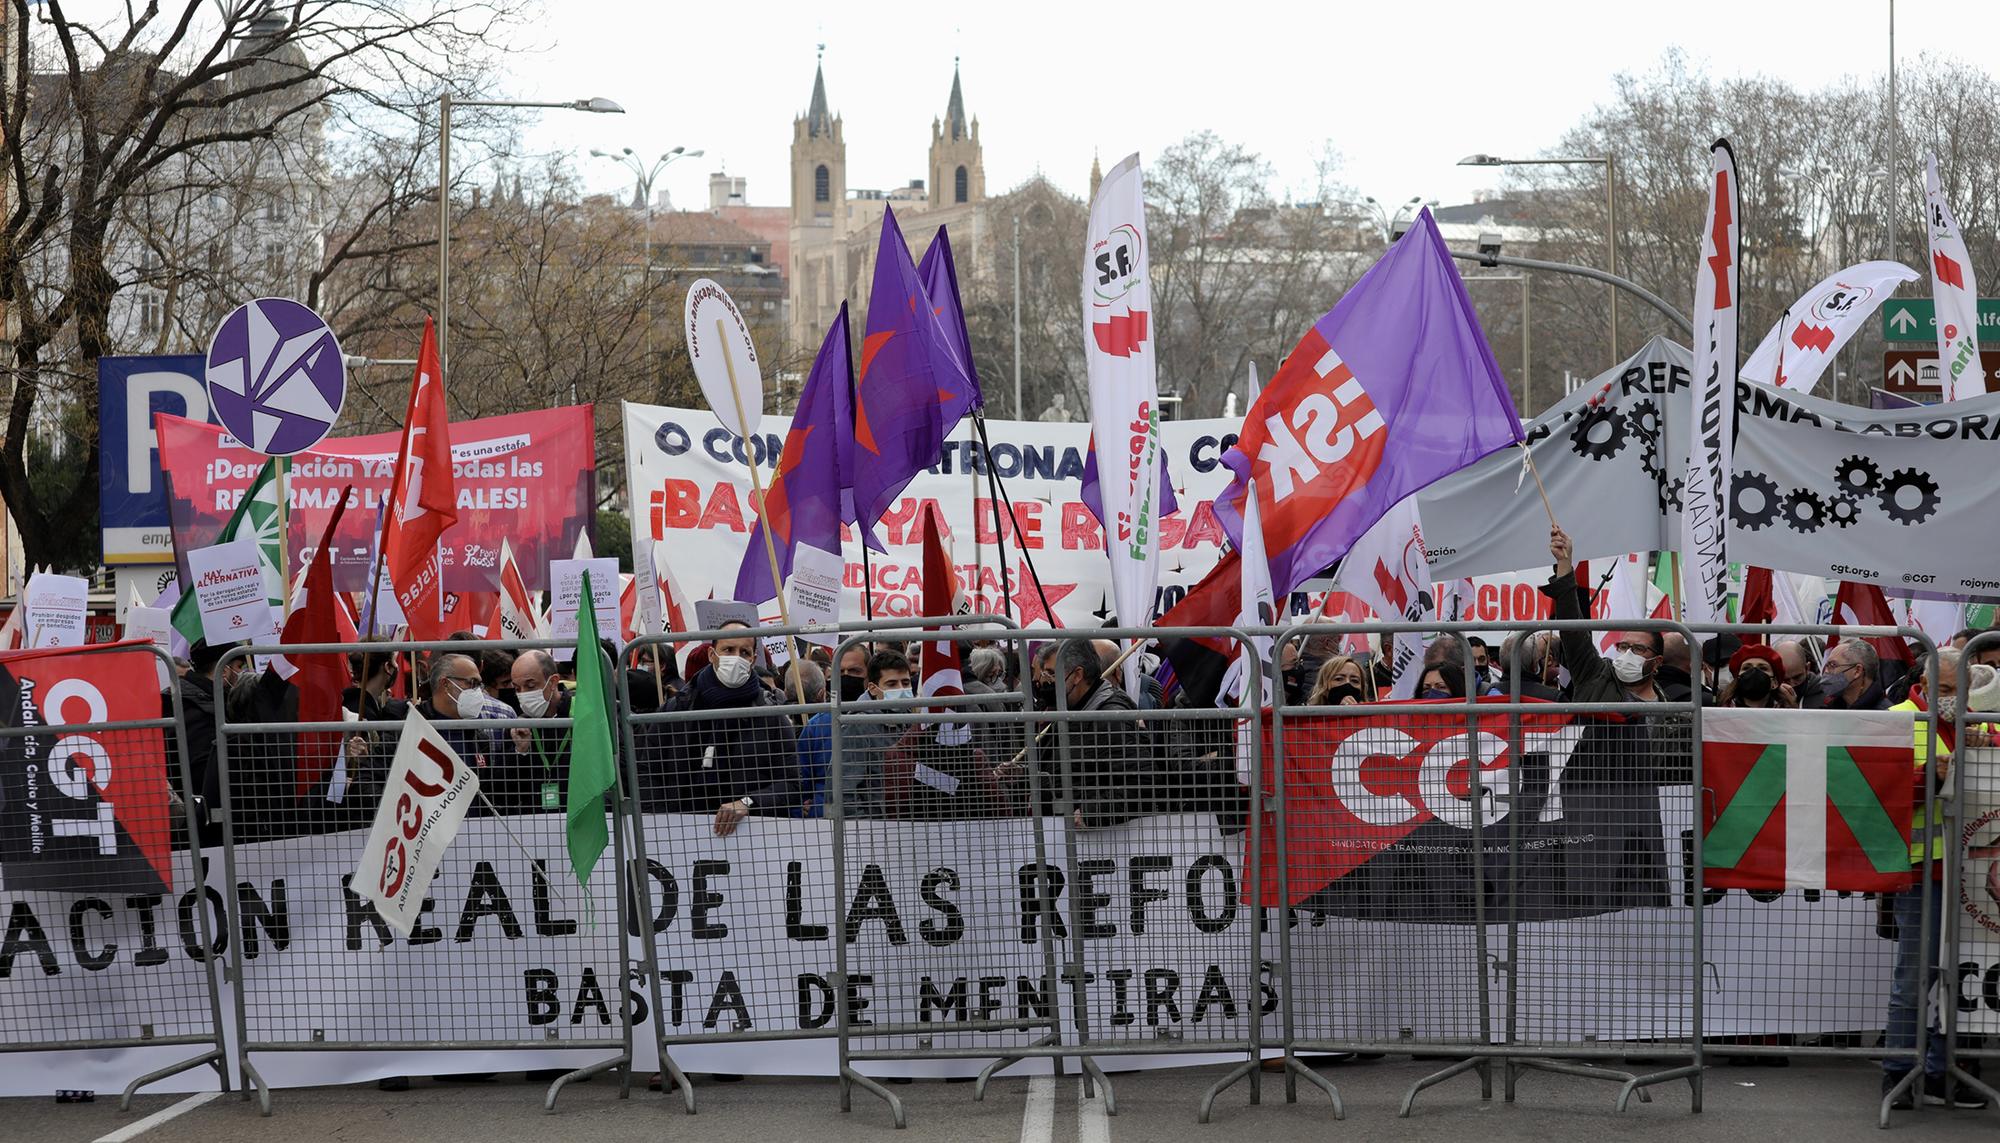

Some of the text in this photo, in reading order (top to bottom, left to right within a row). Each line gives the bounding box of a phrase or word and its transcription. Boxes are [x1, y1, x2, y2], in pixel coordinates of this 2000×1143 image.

[1620, 361, 1822, 428] REFRMA
[127, 371, 209, 494] P
[655, 421, 692, 456] O
[459, 449, 471, 458] es
[473, 446, 493, 456] una
[206, 456, 353, 484] ¡Deración
[452, 459, 505, 478] odas
[511, 456, 543, 478] las
[215, 487, 528, 511] RERMAS LALES!
[974, 498, 1044, 550] DE
[299, 547, 340, 565] CT
[197, 567, 259, 589] ALTERNATIVA
[203, 568, 222, 581] HAY
[1902, 573, 1936, 584] @CGT
[19, 678, 40, 759] Andalcía,
[43, 678, 118, 855] CGT
[1332, 725, 1586, 830] CGT
[26, 802, 38, 810] y
[627, 858, 731, 939] DE
[786, 862, 966, 947] LAS
[1019, 855, 1238, 944] REFO
[523, 960, 1279, 1032] BASTA DE MENTIRAS
